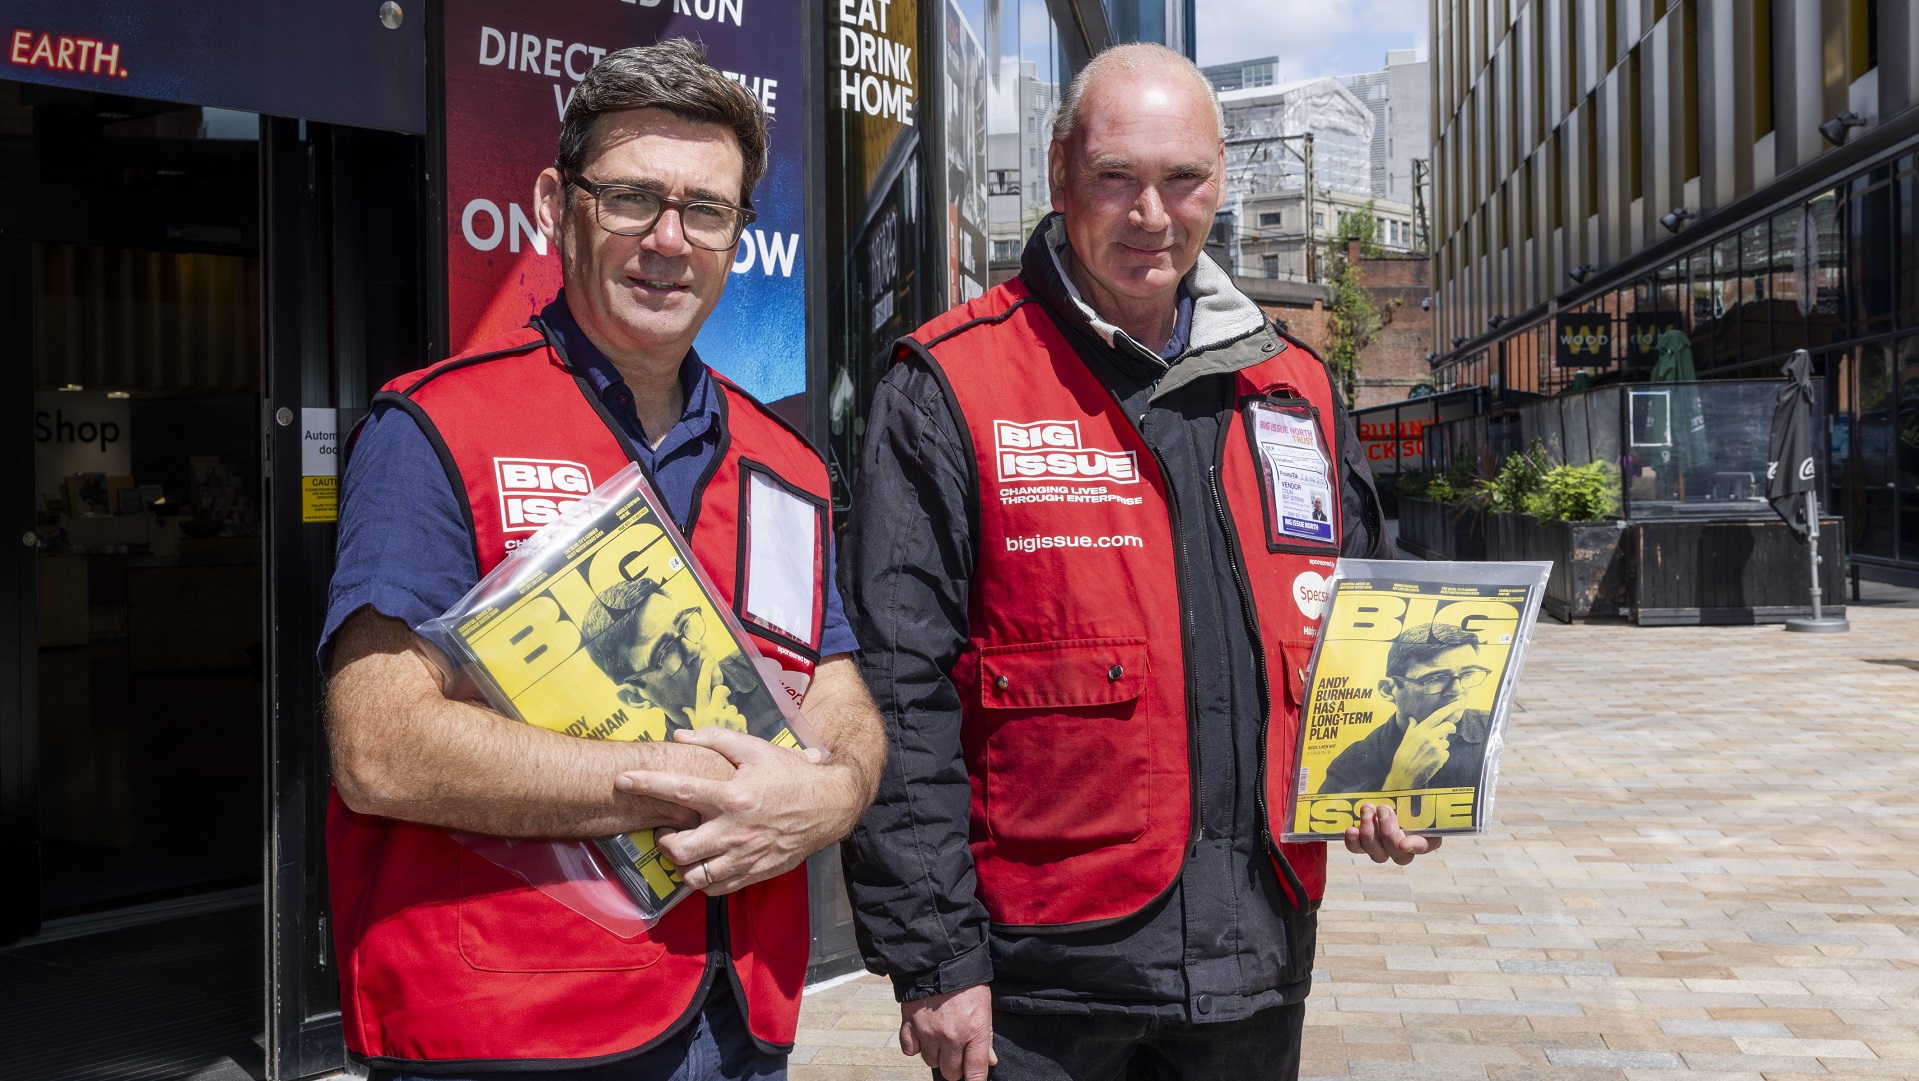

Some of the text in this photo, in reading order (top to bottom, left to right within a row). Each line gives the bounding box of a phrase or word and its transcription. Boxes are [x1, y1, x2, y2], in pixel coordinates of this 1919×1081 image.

[840, 0, 891, 33] EAT
[11, 31, 128, 77] EARTH.
[840, 26, 912, 84] DRINK
[841, 69, 914, 126] HOME
[461, 198, 800, 278] ON OW
[1560, 335, 1608, 345] WOOD
[35, 409, 120, 453] Shop
[304, 430, 337, 441] Autom
[1000, 425, 1075, 448] BIG
[1260, 421, 1312, 438] BIG ISSUE NORTH
[1292, 434, 1314, 446] TRUST
[1002, 453, 1133, 478] ISSUE
[312, 478, 338, 487] CAUTI
[501, 464, 588, 493] BIG
[1281, 481, 1302, 490] VENDOR
[1000, 486, 1107, 497] CHANGING LIVES
[1000, 494, 1143, 506] THROUGH ENTERPRISE
[1293, 520, 1305, 528] ISSUE
[1305, 521, 1319, 530] NORTH
[1006, 534, 1143, 553] bigissue.com
[471, 523, 687, 699] BIG
[1325, 594, 1519, 645] BIG
[804, 656, 811, 666] by
[1318, 676, 1350, 690] ANDY
[1316, 688, 1373, 702] BURNHAM
[1313, 700, 1344, 714] HAS A
[565, 715, 590, 738] NDY
[586, 708, 630, 740] NHAM
[1311, 712, 1373, 727] LONG-TERM
[1309, 726, 1338, 740] PLAN
